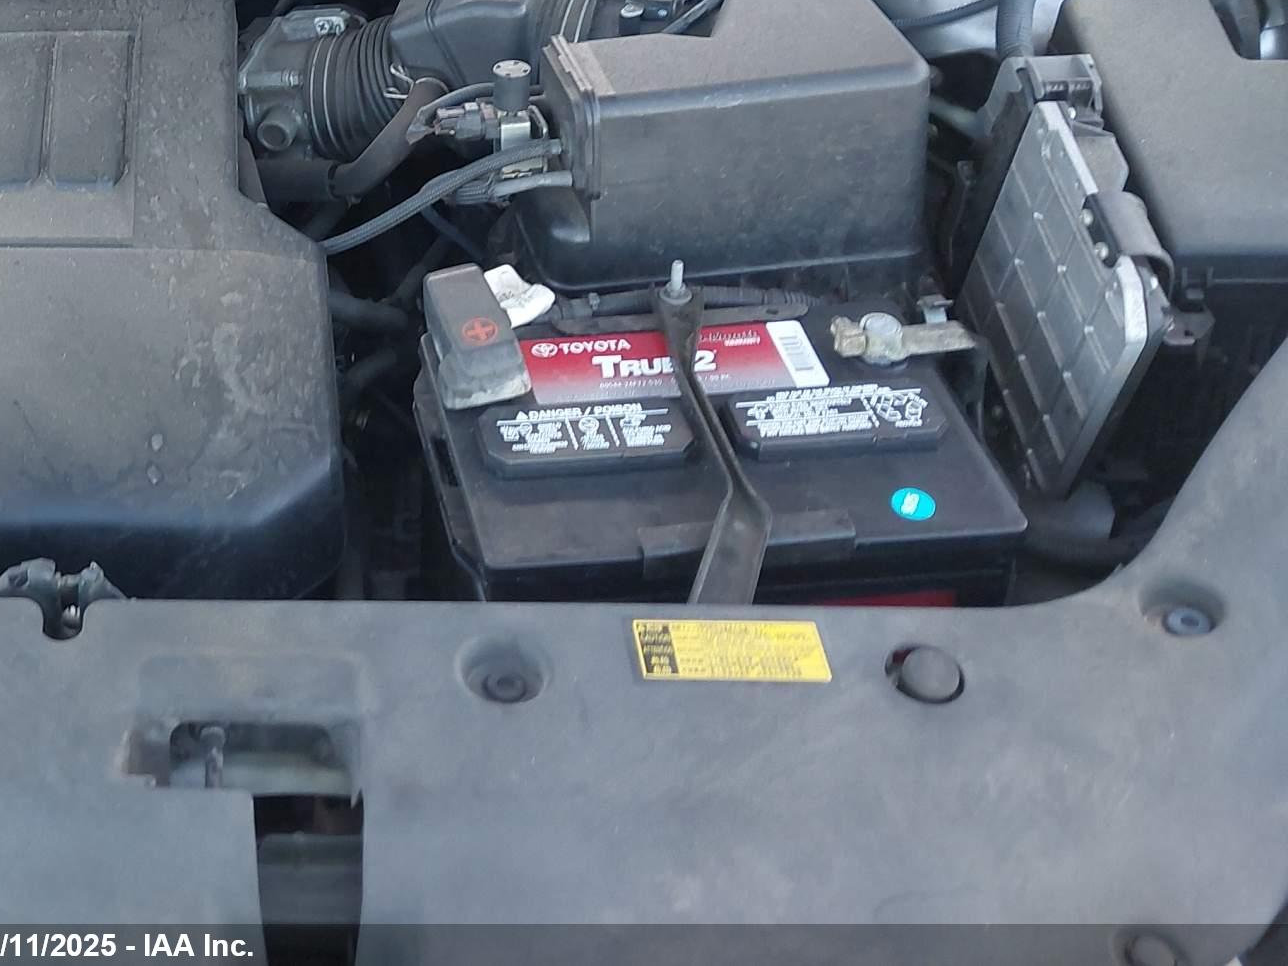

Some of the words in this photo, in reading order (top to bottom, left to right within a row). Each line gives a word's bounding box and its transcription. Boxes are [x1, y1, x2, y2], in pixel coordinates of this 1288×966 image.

[559, 339, 631, 356] TOYOTA
[528, 407, 583, 420] DANGER
[593, 403, 643, 416] POISON
